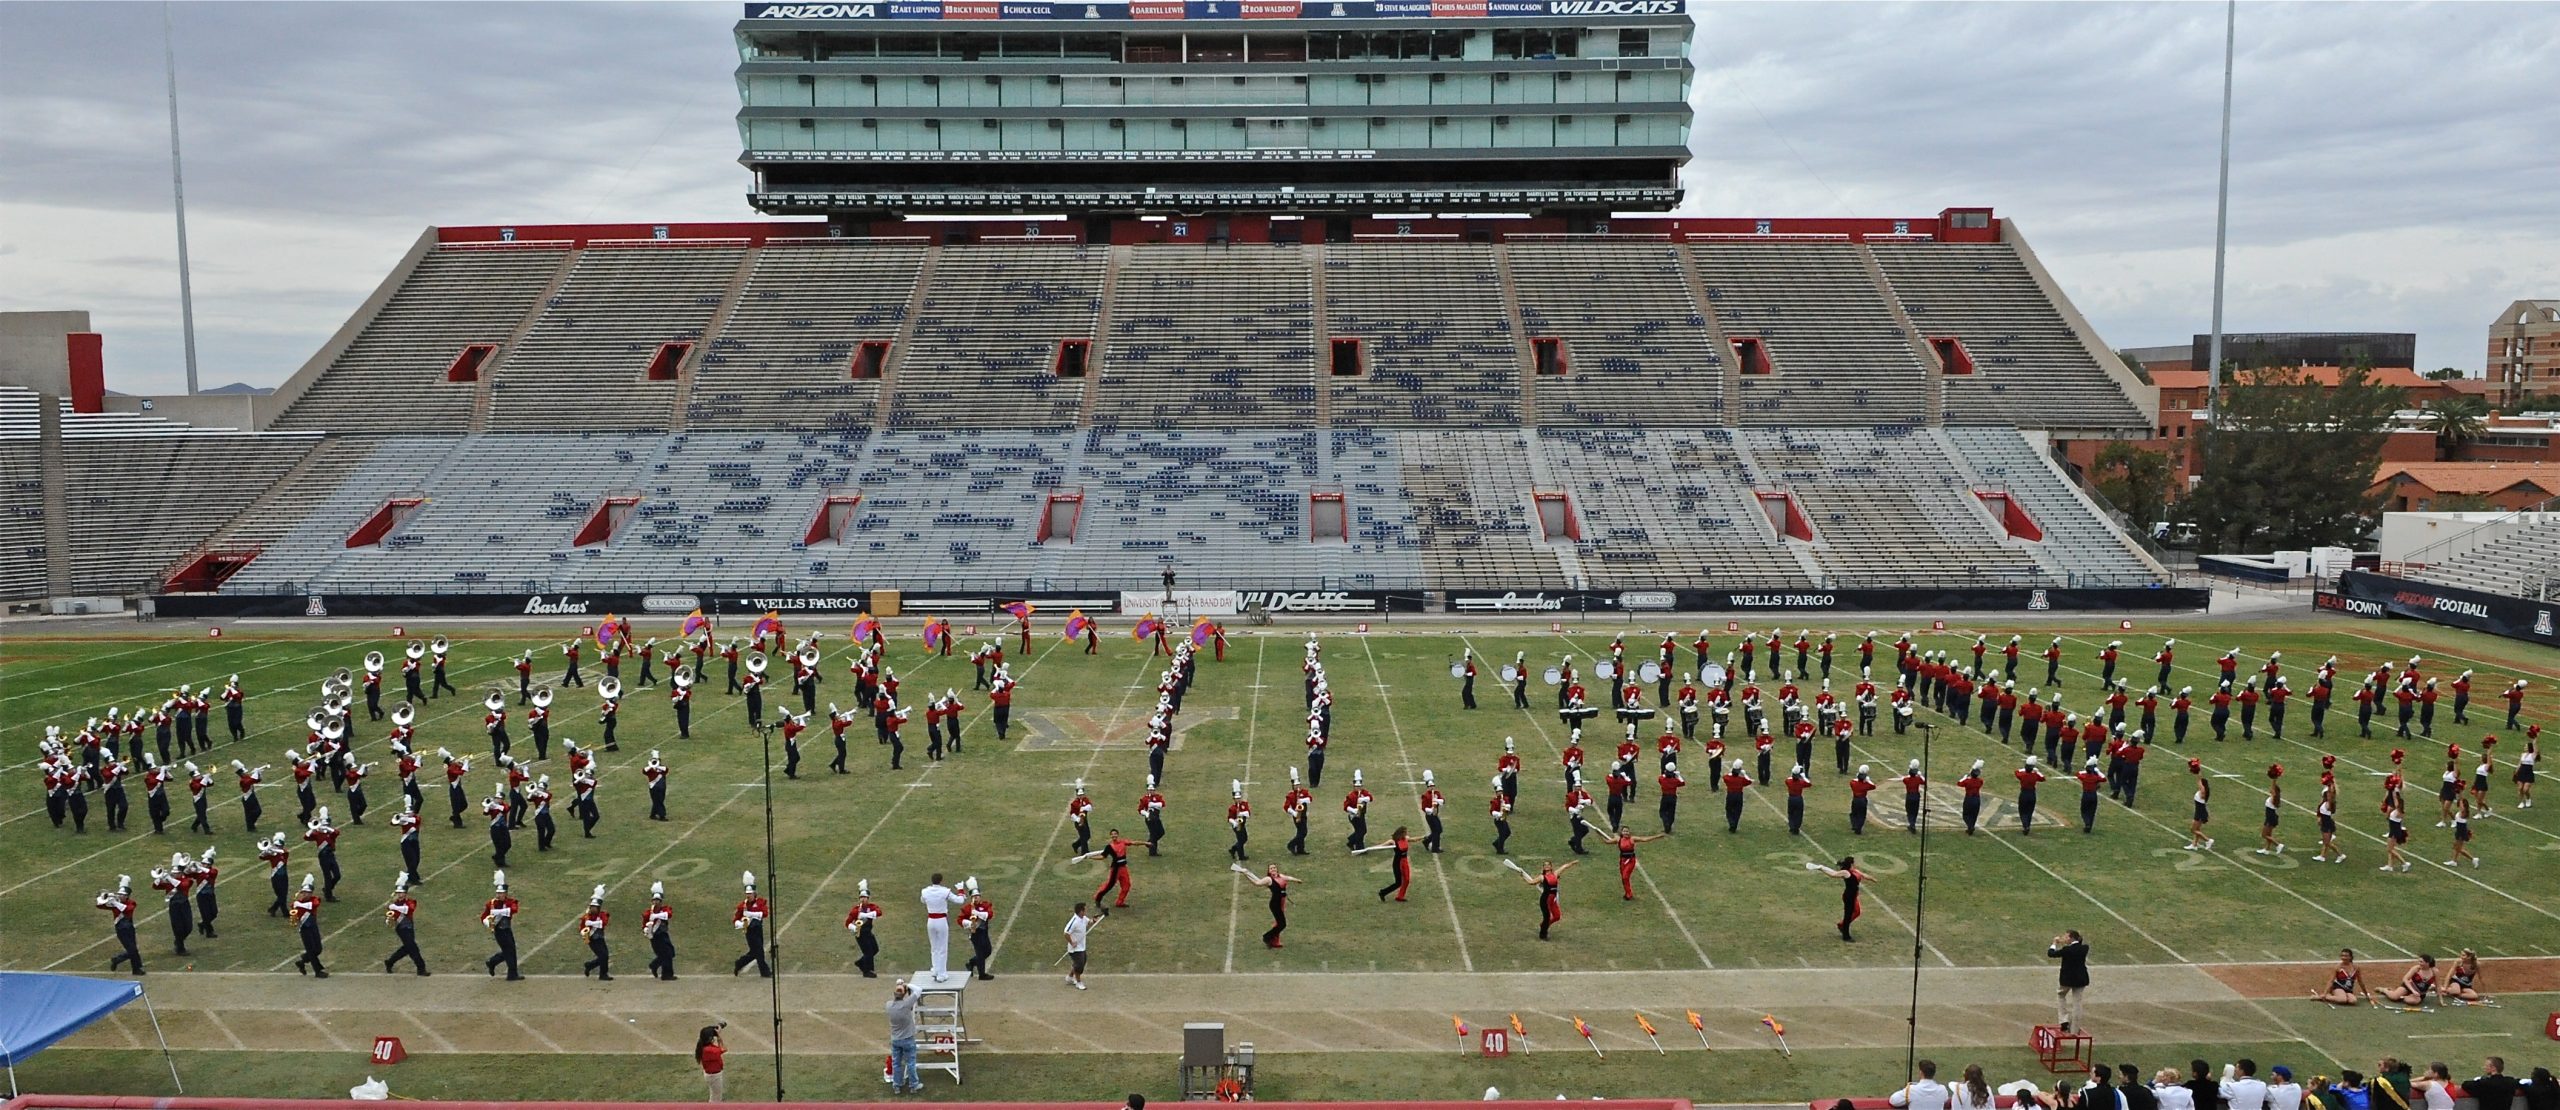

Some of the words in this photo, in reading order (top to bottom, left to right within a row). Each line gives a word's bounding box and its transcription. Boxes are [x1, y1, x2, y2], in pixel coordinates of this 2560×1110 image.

[758, 4, 875, 18] ARIZONA
[890, 5, 898, 14] 22
[899, 6, 911, 14] ART
[912, 6, 940, 14] LUPPINO
[953, 6, 974, 14] RICKY
[975, 6, 997, 14] HUNLEY
[1009, 6, 1031, 14] CHUCK
[1033, 6, 1051, 14] CECIL
[1130, 6, 1135, 14] 4
[1136, 6, 1163, 14] DARRYLL
[1165, 6, 1184, 14] LEWIS
[1250, 5, 1264, 13] ROB
[1264, 5, 1295, 13] WALDROP
[1384, 4, 1398, 12] STEVE
[1551, 1, 1678, 14] WILDCATS
[830, 229, 841, 237] 19
[1026, 227, 1039, 236] 20
[1175, 226, 1186, 235] 21
[1398, 225, 1410, 234] 22
[1595, 225, 1608, 233] 23
[1757, 225, 1770, 234] 24
[1895, 225, 1907, 234] 25
[503, 232, 513, 241] 17
[655, 230, 666, 239] 18
[142, 400, 152, 409] 16
[524, 596, 589, 614] Bashas'
[753, 598, 805, 609] WELLS
[808, 598, 858, 609] FARGO
[1124, 598, 1158, 608] UNIVERSITY
[1200, 598, 1218, 608] BAND
[1220, 598, 1233, 608] DAY
[1730, 595, 1782, 606] WELLS
[1785, 595, 1835, 606] FARGO
[2318, 593, 2345, 609] BEAR
[2345, 599, 2382, 615] DOWN
[2394, 591, 2435, 609] ARIZONA
[2433, 597, 2488, 618] FOOTBALL
[1486, 1033, 1504, 1052] 40
[373, 1041, 391, 1060] 40
